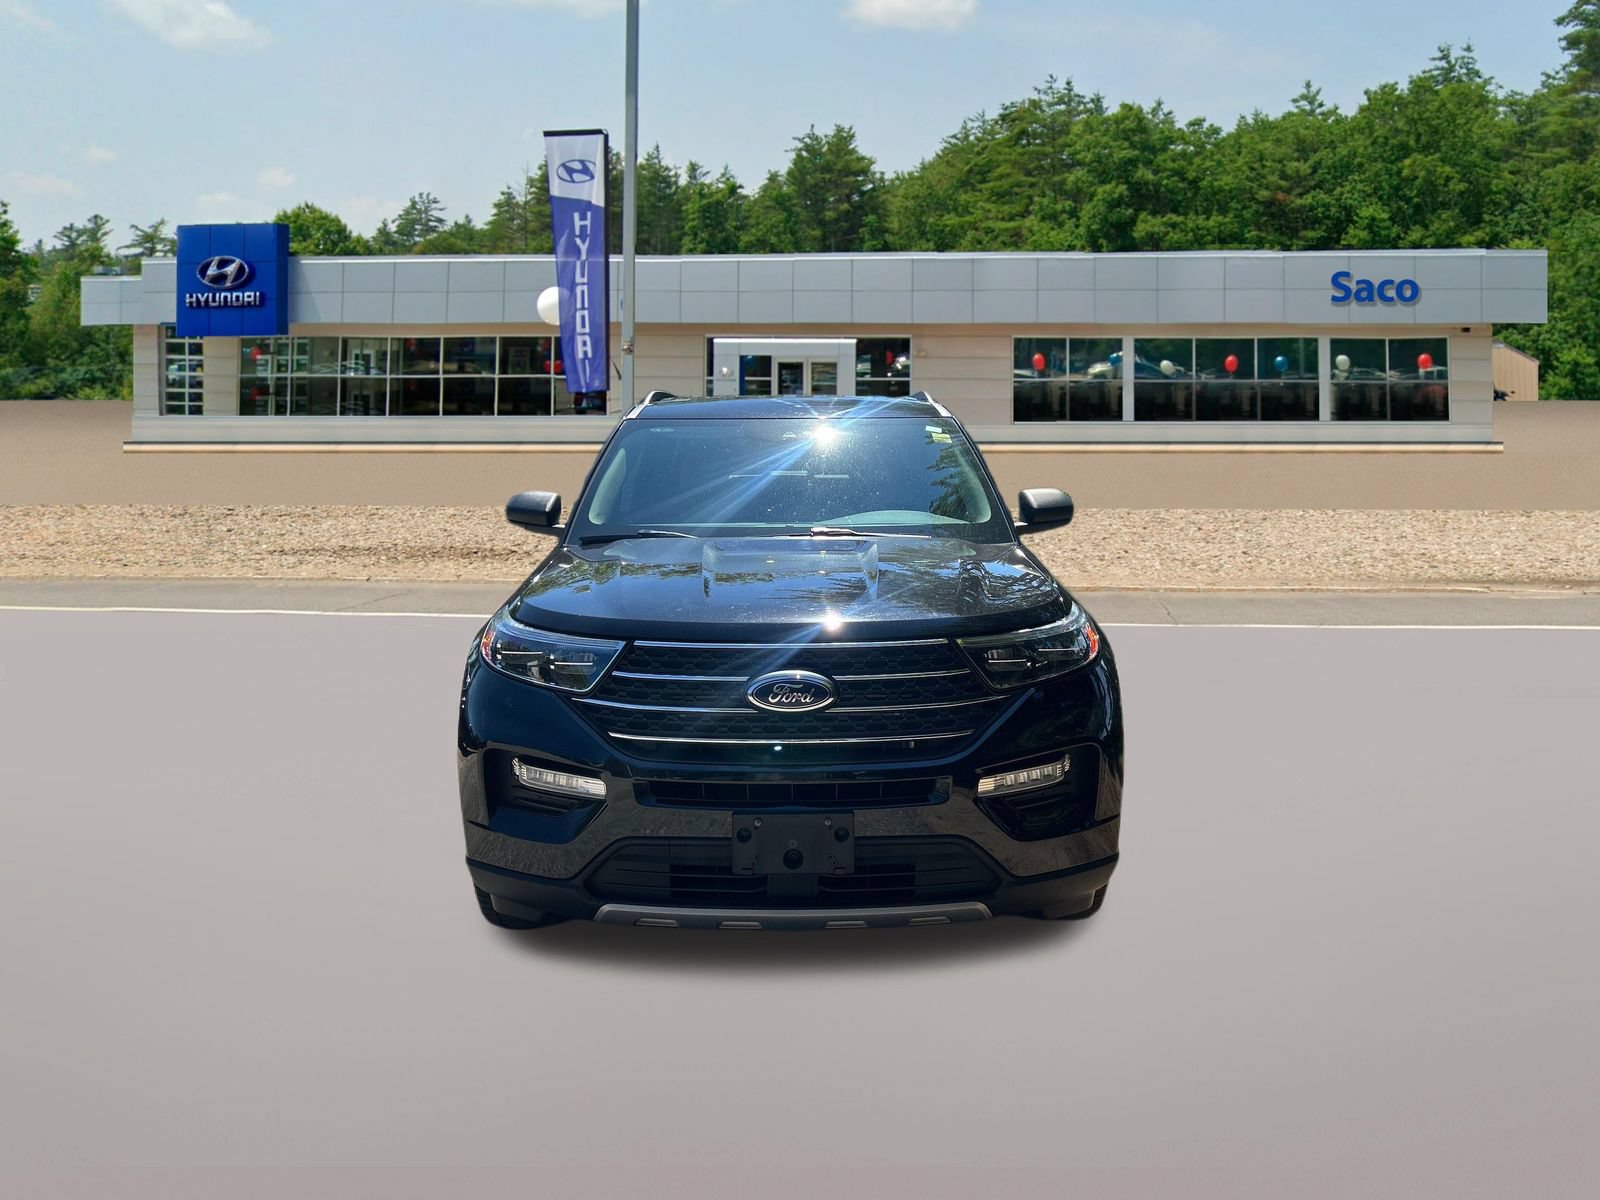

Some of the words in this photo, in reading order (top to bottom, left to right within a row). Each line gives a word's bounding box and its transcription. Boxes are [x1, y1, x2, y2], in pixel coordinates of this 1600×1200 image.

[185, 291, 261, 307] HYUNDAI
[573, 211, 592, 384] HYUNDAI
[1330, 271, 1420, 303] Saco
[768, 683, 815, 703] Ford
